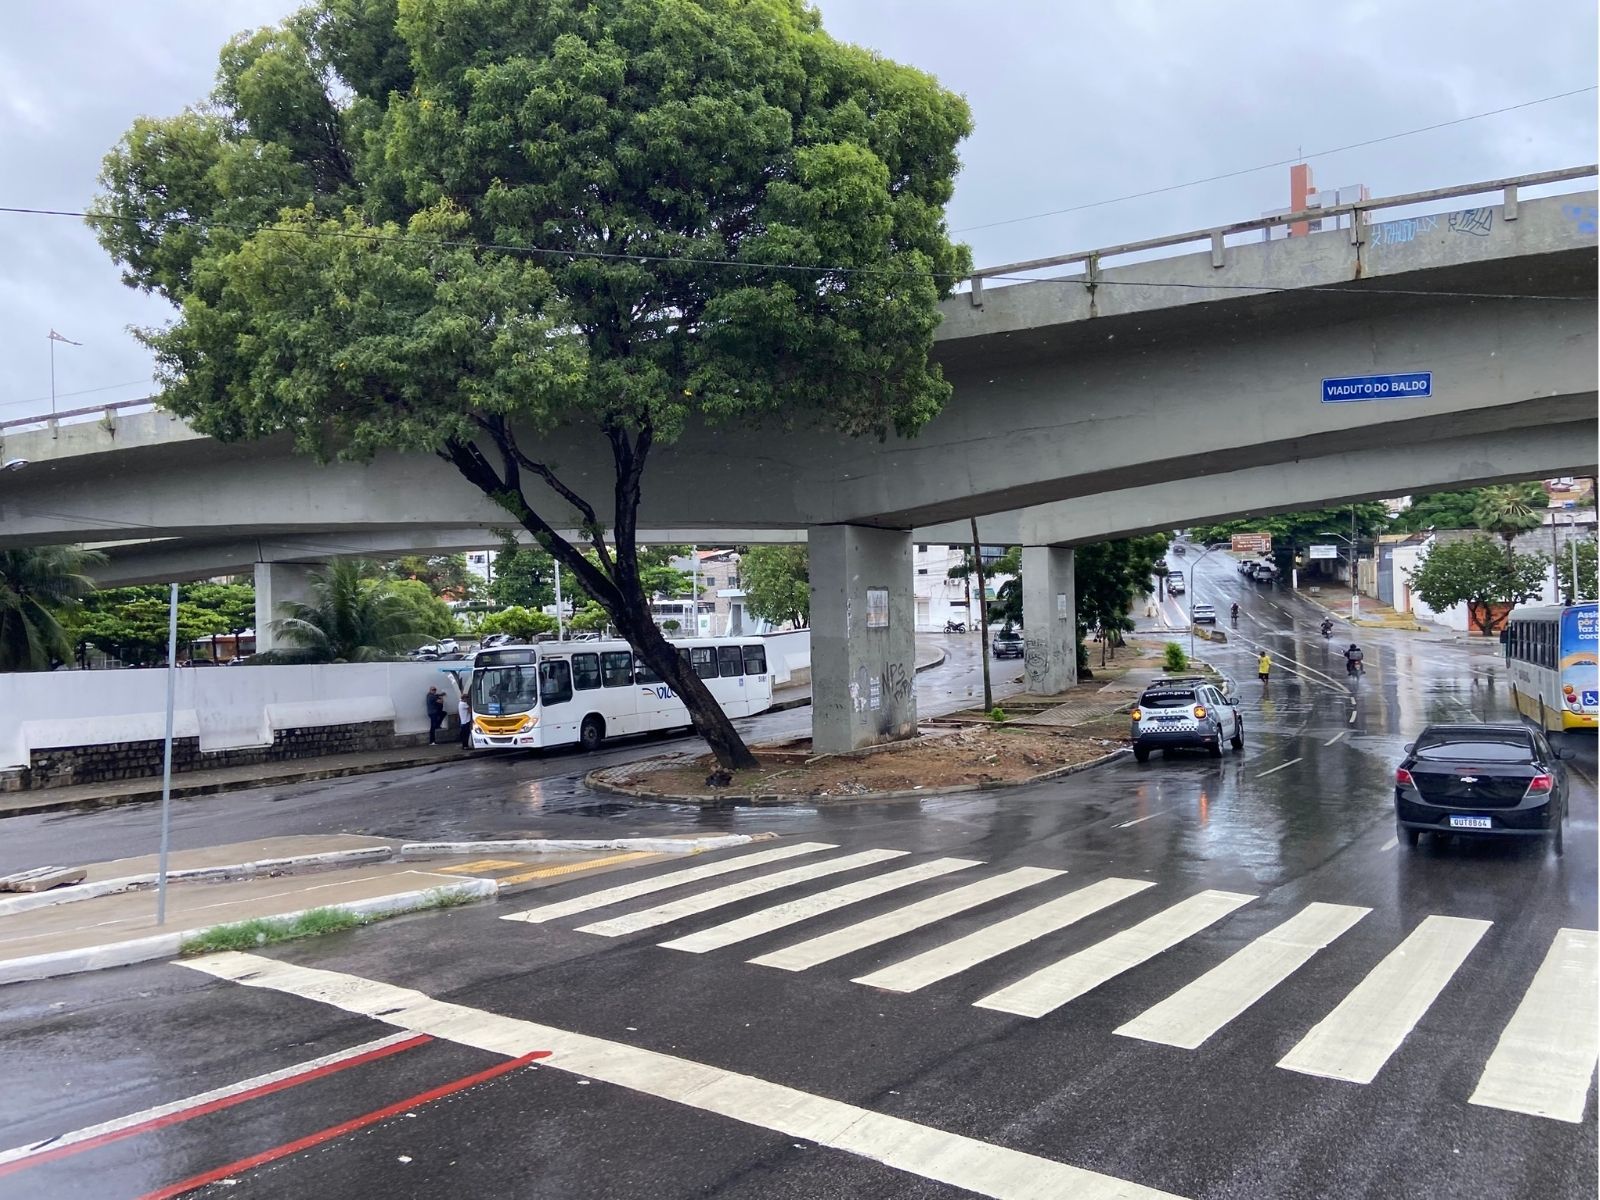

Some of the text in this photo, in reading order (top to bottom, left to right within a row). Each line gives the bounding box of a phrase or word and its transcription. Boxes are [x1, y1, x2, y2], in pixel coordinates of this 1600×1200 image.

[1327, 380, 1427, 396] VIADUTO DO BALDO
